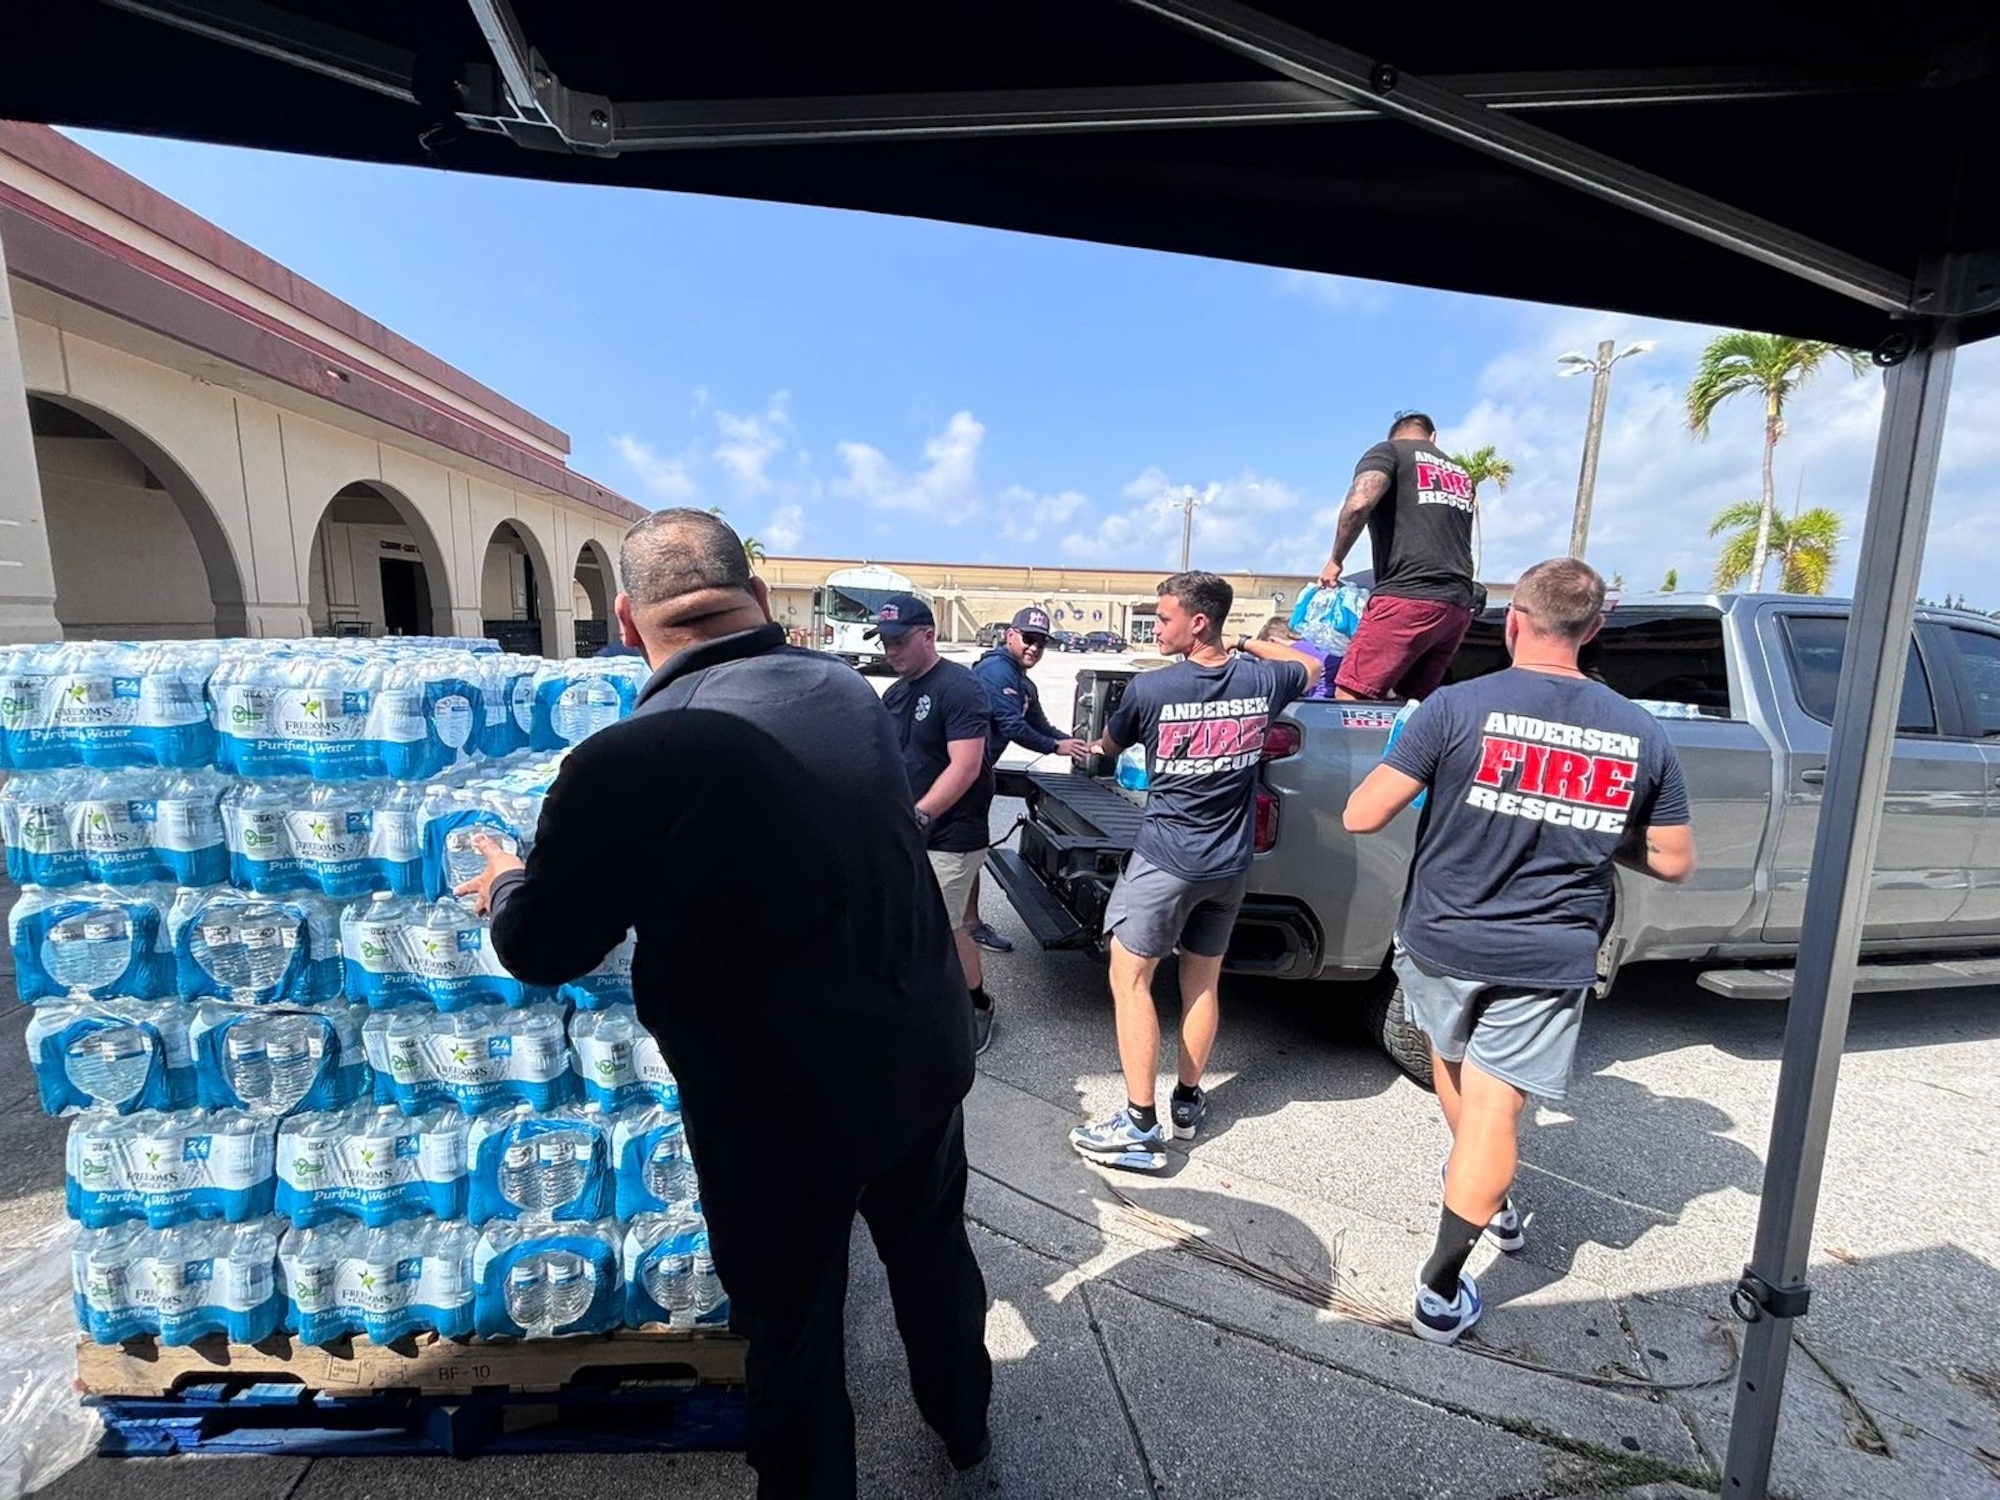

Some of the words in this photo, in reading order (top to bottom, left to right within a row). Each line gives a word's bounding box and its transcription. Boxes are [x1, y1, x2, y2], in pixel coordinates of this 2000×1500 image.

[1418, 490, 1473, 513] RESCU
[115, 680, 139, 692] 24
[345, 694, 366, 707] 24
[1159, 697, 1269, 720] ANDERSEN
[285, 720, 340, 733] FREEDOM'S
[1157, 714, 1268, 759] FIRE
[1483, 712, 1640, 758] ANDERSEN
[257, 741, 308, 752] Purified
[315, 742, 356, 753] Water
[1474, 736, 1638, 811] FIRE
[131, 803, 154, 816] 24
[1465, 786, 1628, 834] RESCUE
[105, 852, 148, 864] Water
[323, 862, 362, 874] Water
[459, 932, 480, 943] 24
[436, 979, 471, 991] Water
[491, 1040, 511, 1050] 24
[466, 1084, 503, 1096] Water
[187, 1140, 209, 1151] 24
[368, 1186, 406, 1202] Water
[187, 1263, 212, 1275] 24
[399, 1263, 420, 1275] 24
[314, 1307, 364, 1322] Purified
[369, 1310, 405, 1324] Water
